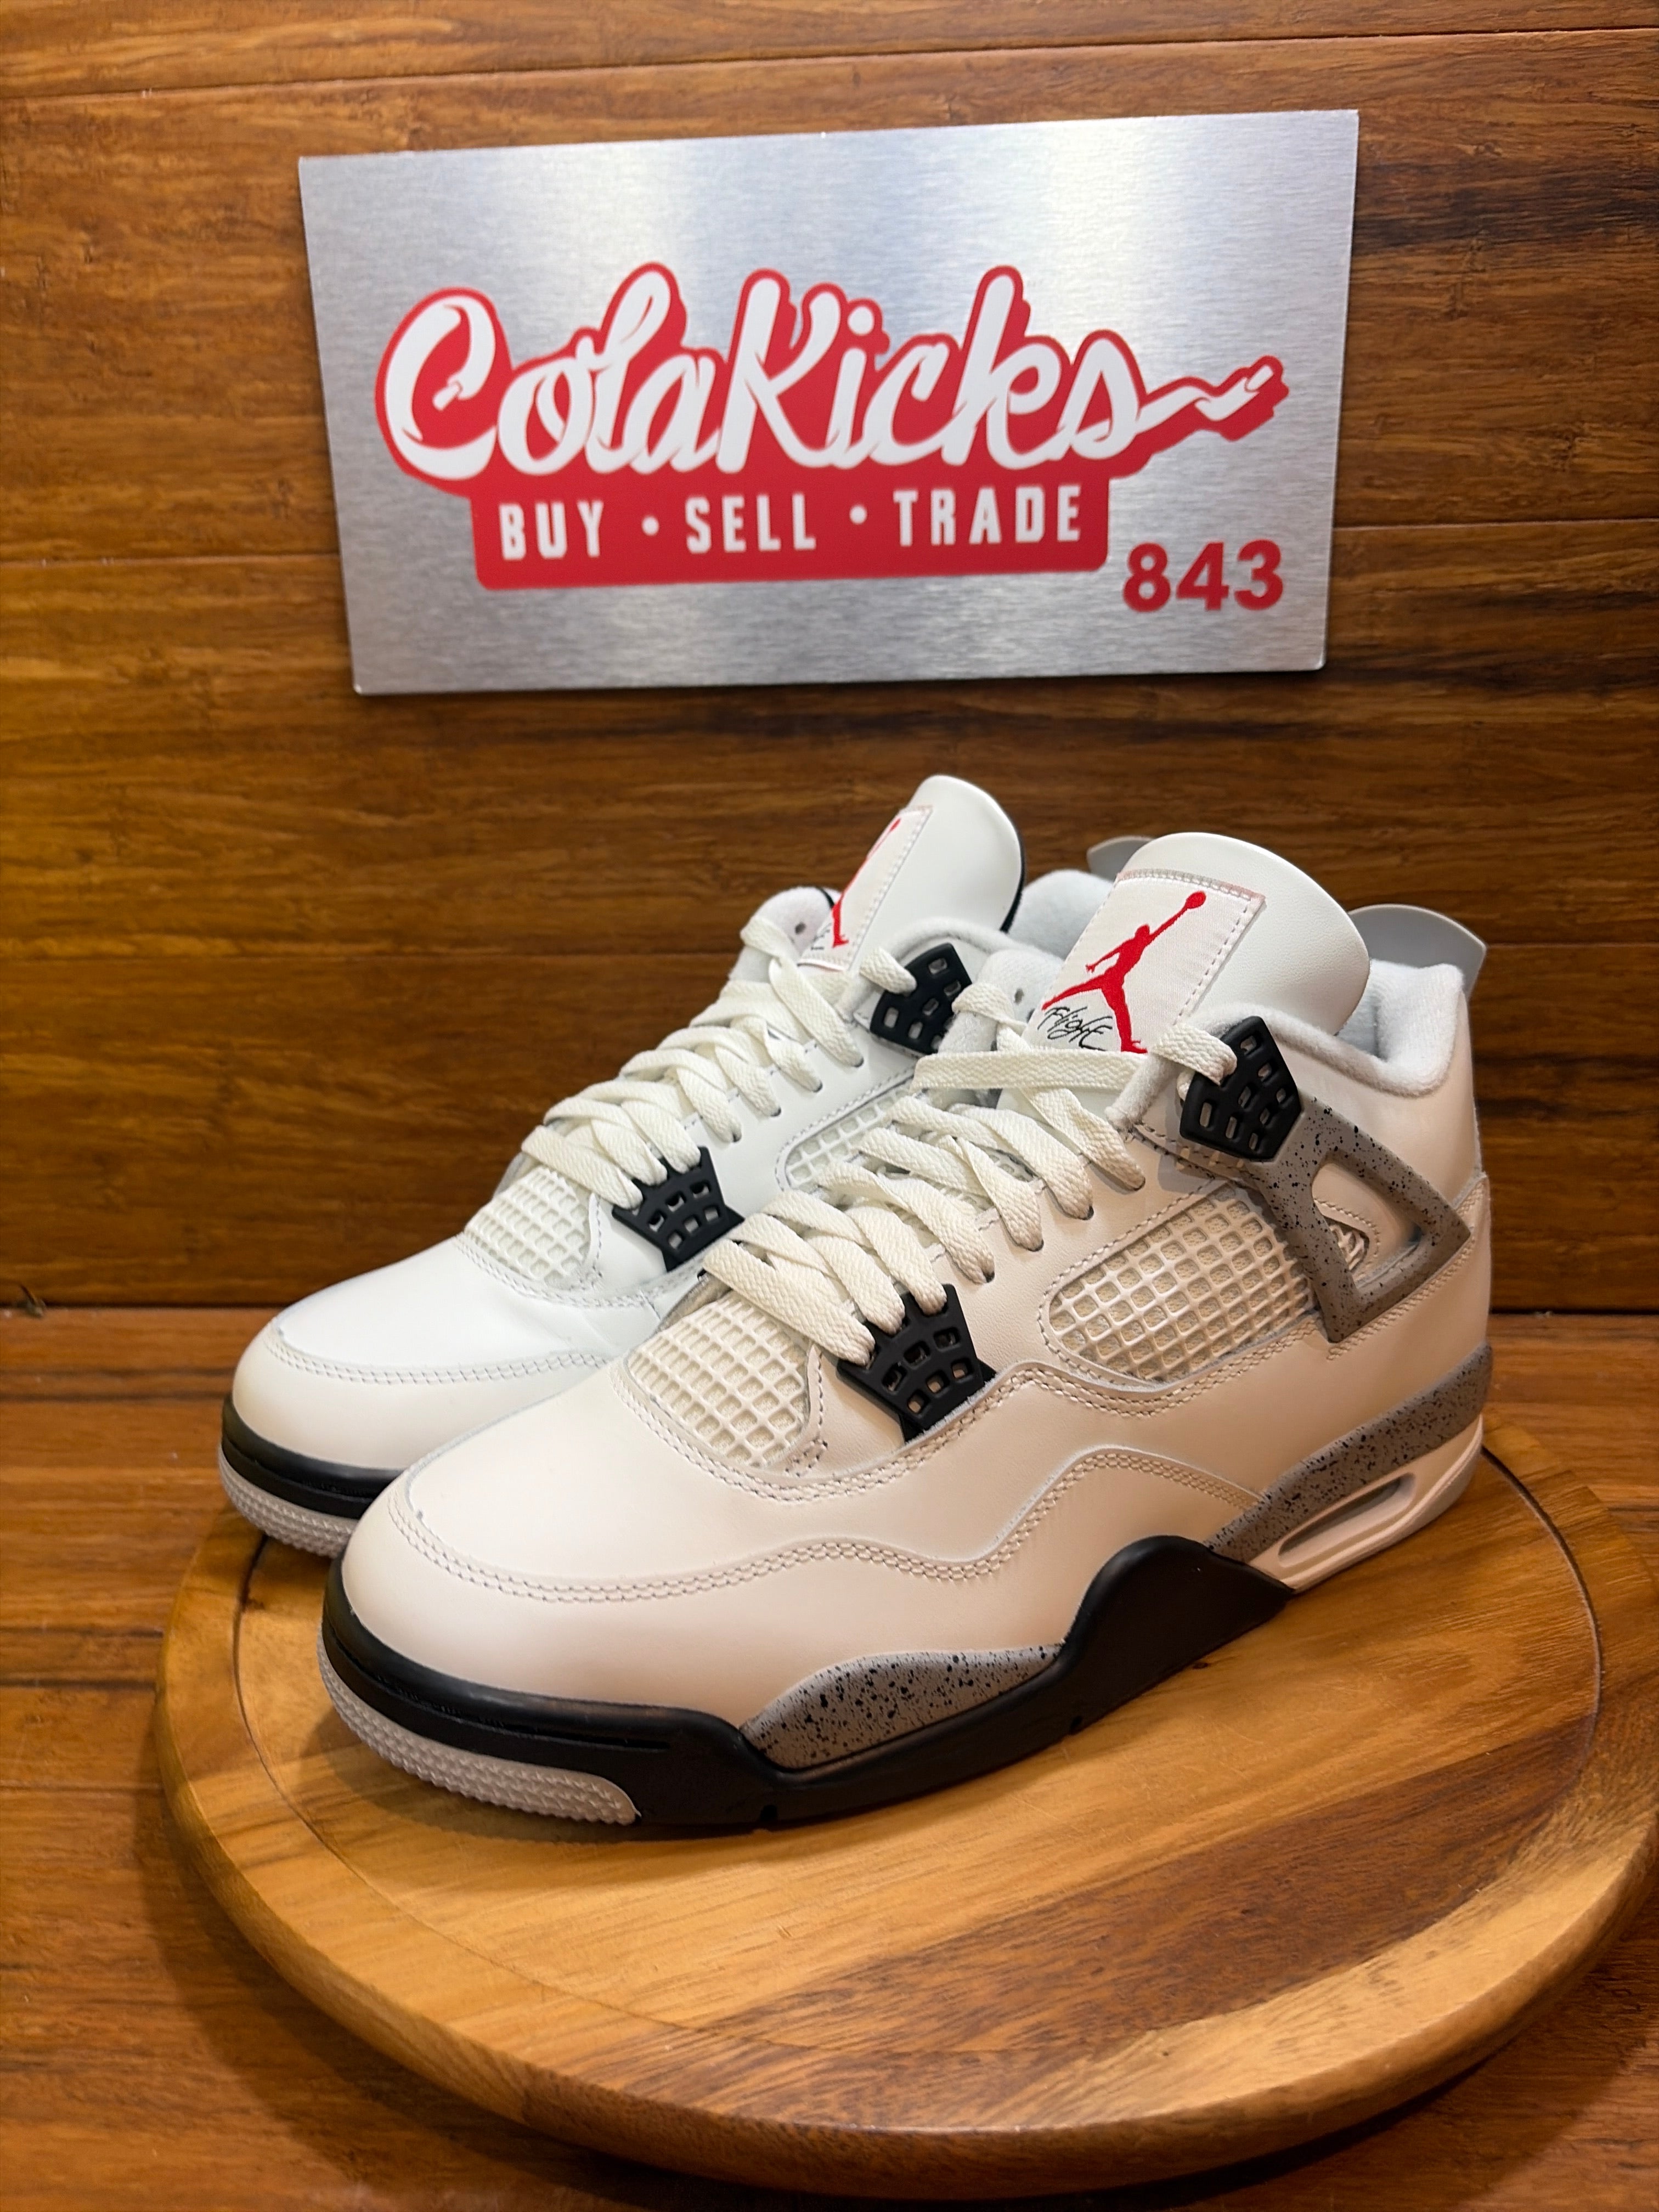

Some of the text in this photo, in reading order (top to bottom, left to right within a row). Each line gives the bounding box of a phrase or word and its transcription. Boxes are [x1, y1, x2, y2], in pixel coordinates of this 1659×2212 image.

[384, 269, 1274, 481] ColaKicks
[499, 484, 1081, 560] BUY SELL TRADE
[1122, 538, 1284, 613] 843
